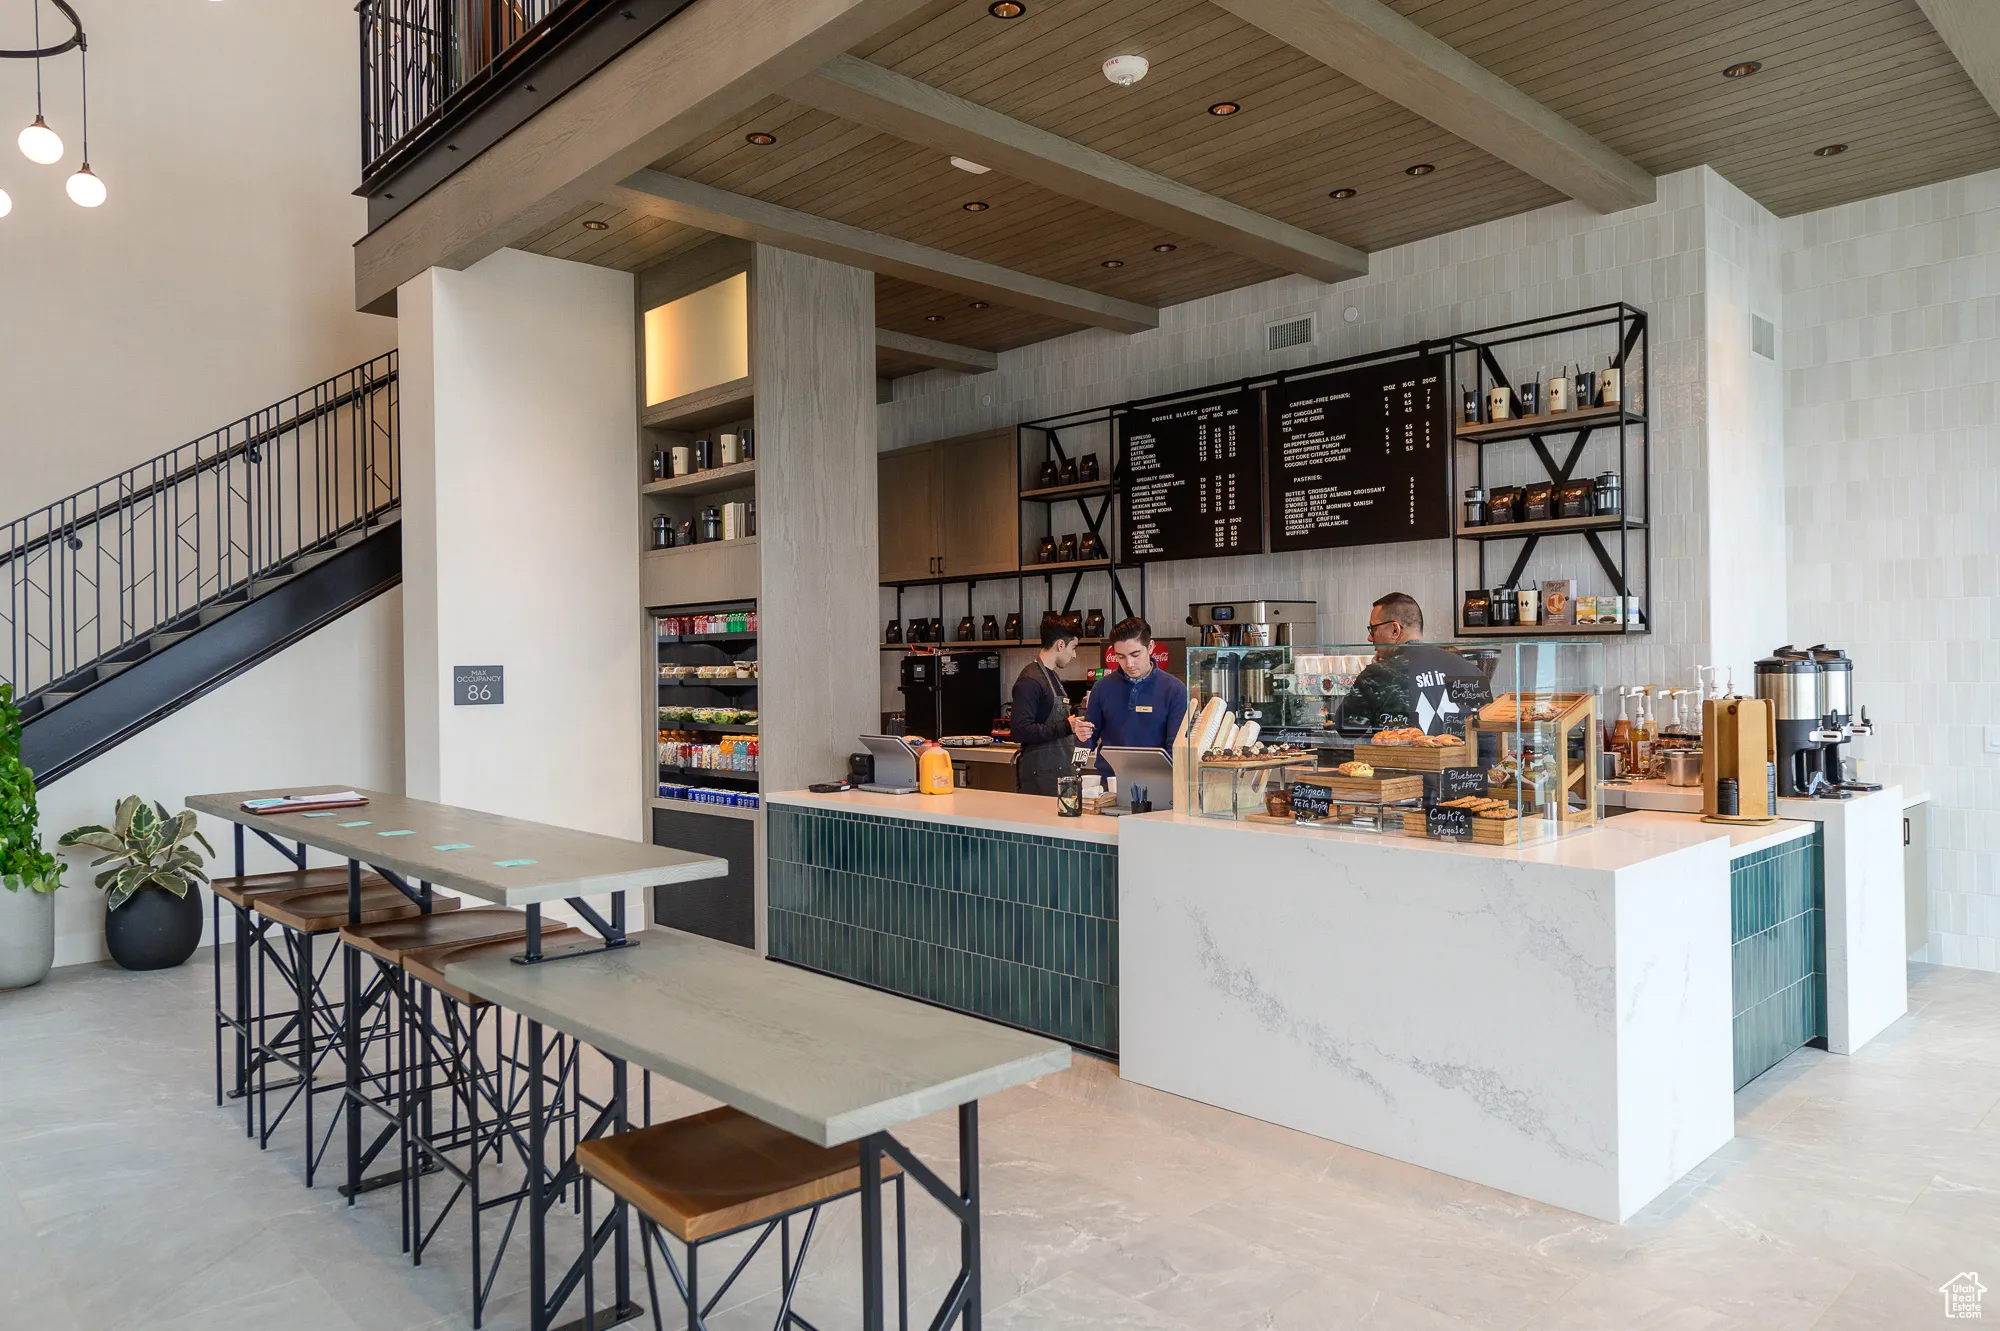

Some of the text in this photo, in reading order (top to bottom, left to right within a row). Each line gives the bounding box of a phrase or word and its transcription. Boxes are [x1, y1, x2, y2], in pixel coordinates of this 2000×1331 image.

[1106, 59, 1119, 68] FIRE
[1290, 396, 1328, 408] CAFFEINE-FREE
[1152, 414, 1172, 422] DOUBLE
[1294, 408, 1323, 417] CHOCOLATE
[1416, 671, 1434, 687] ski
[1452, 680, 1479, 690] Almond
[468, 685, 491, 700] 86
[1380, 713, 1409, 725] Plain
[1448, 770, 1483, 781] Blueberry
[1294, 785, 1325, 799] Spinach
[1430, 808, 1465, 822] Cookie
